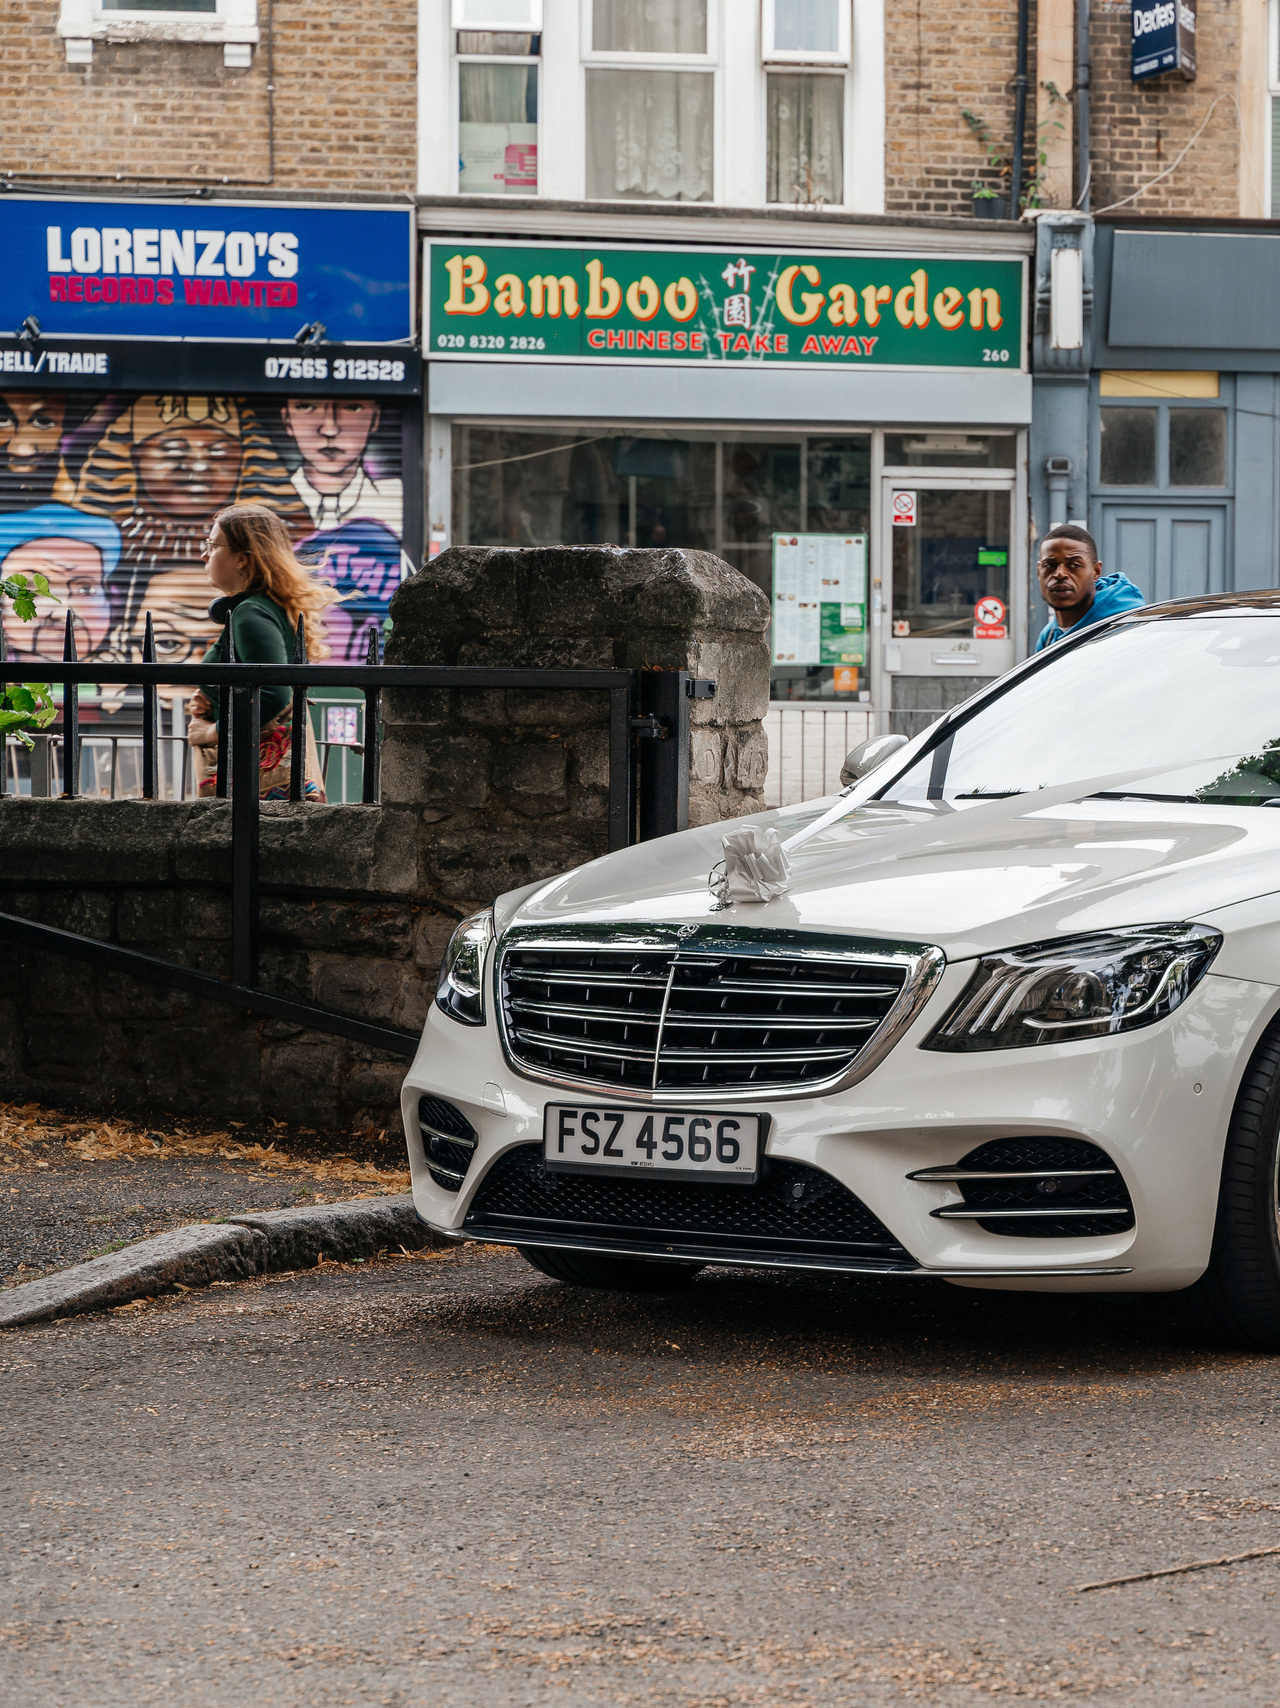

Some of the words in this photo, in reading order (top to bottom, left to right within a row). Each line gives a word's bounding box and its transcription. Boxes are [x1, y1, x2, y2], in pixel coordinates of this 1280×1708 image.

[1133, 2, 1175, 37] Dexters
[47, 226, 299, 278] LORENZO'S
[49, 275, 174, 305] RECORDS
[184, 279, 298, 308] WANTED
[443, 254, 700, 322] Bamboo
[775, 264, 1004, 330] Garden
[721, 258, 757, 331] 竹園
[437, 334, 465, 349] 020
[468, 335, 501, 351] 8320
[503, 336, 545, 351] 2826
[587, 328, 704, 352] CHINESE
[718, 331, 789, 354] TAKE
[802, 334, 878, 357] AWAY
[982, 348, 1010, 363] 260
[265, 357, 328, 379] 07565
[333, 358, 405, 381] 312528
[557, 1109, 625, 1158] FSZ
[635, 1115, 741, 1164] 4566
